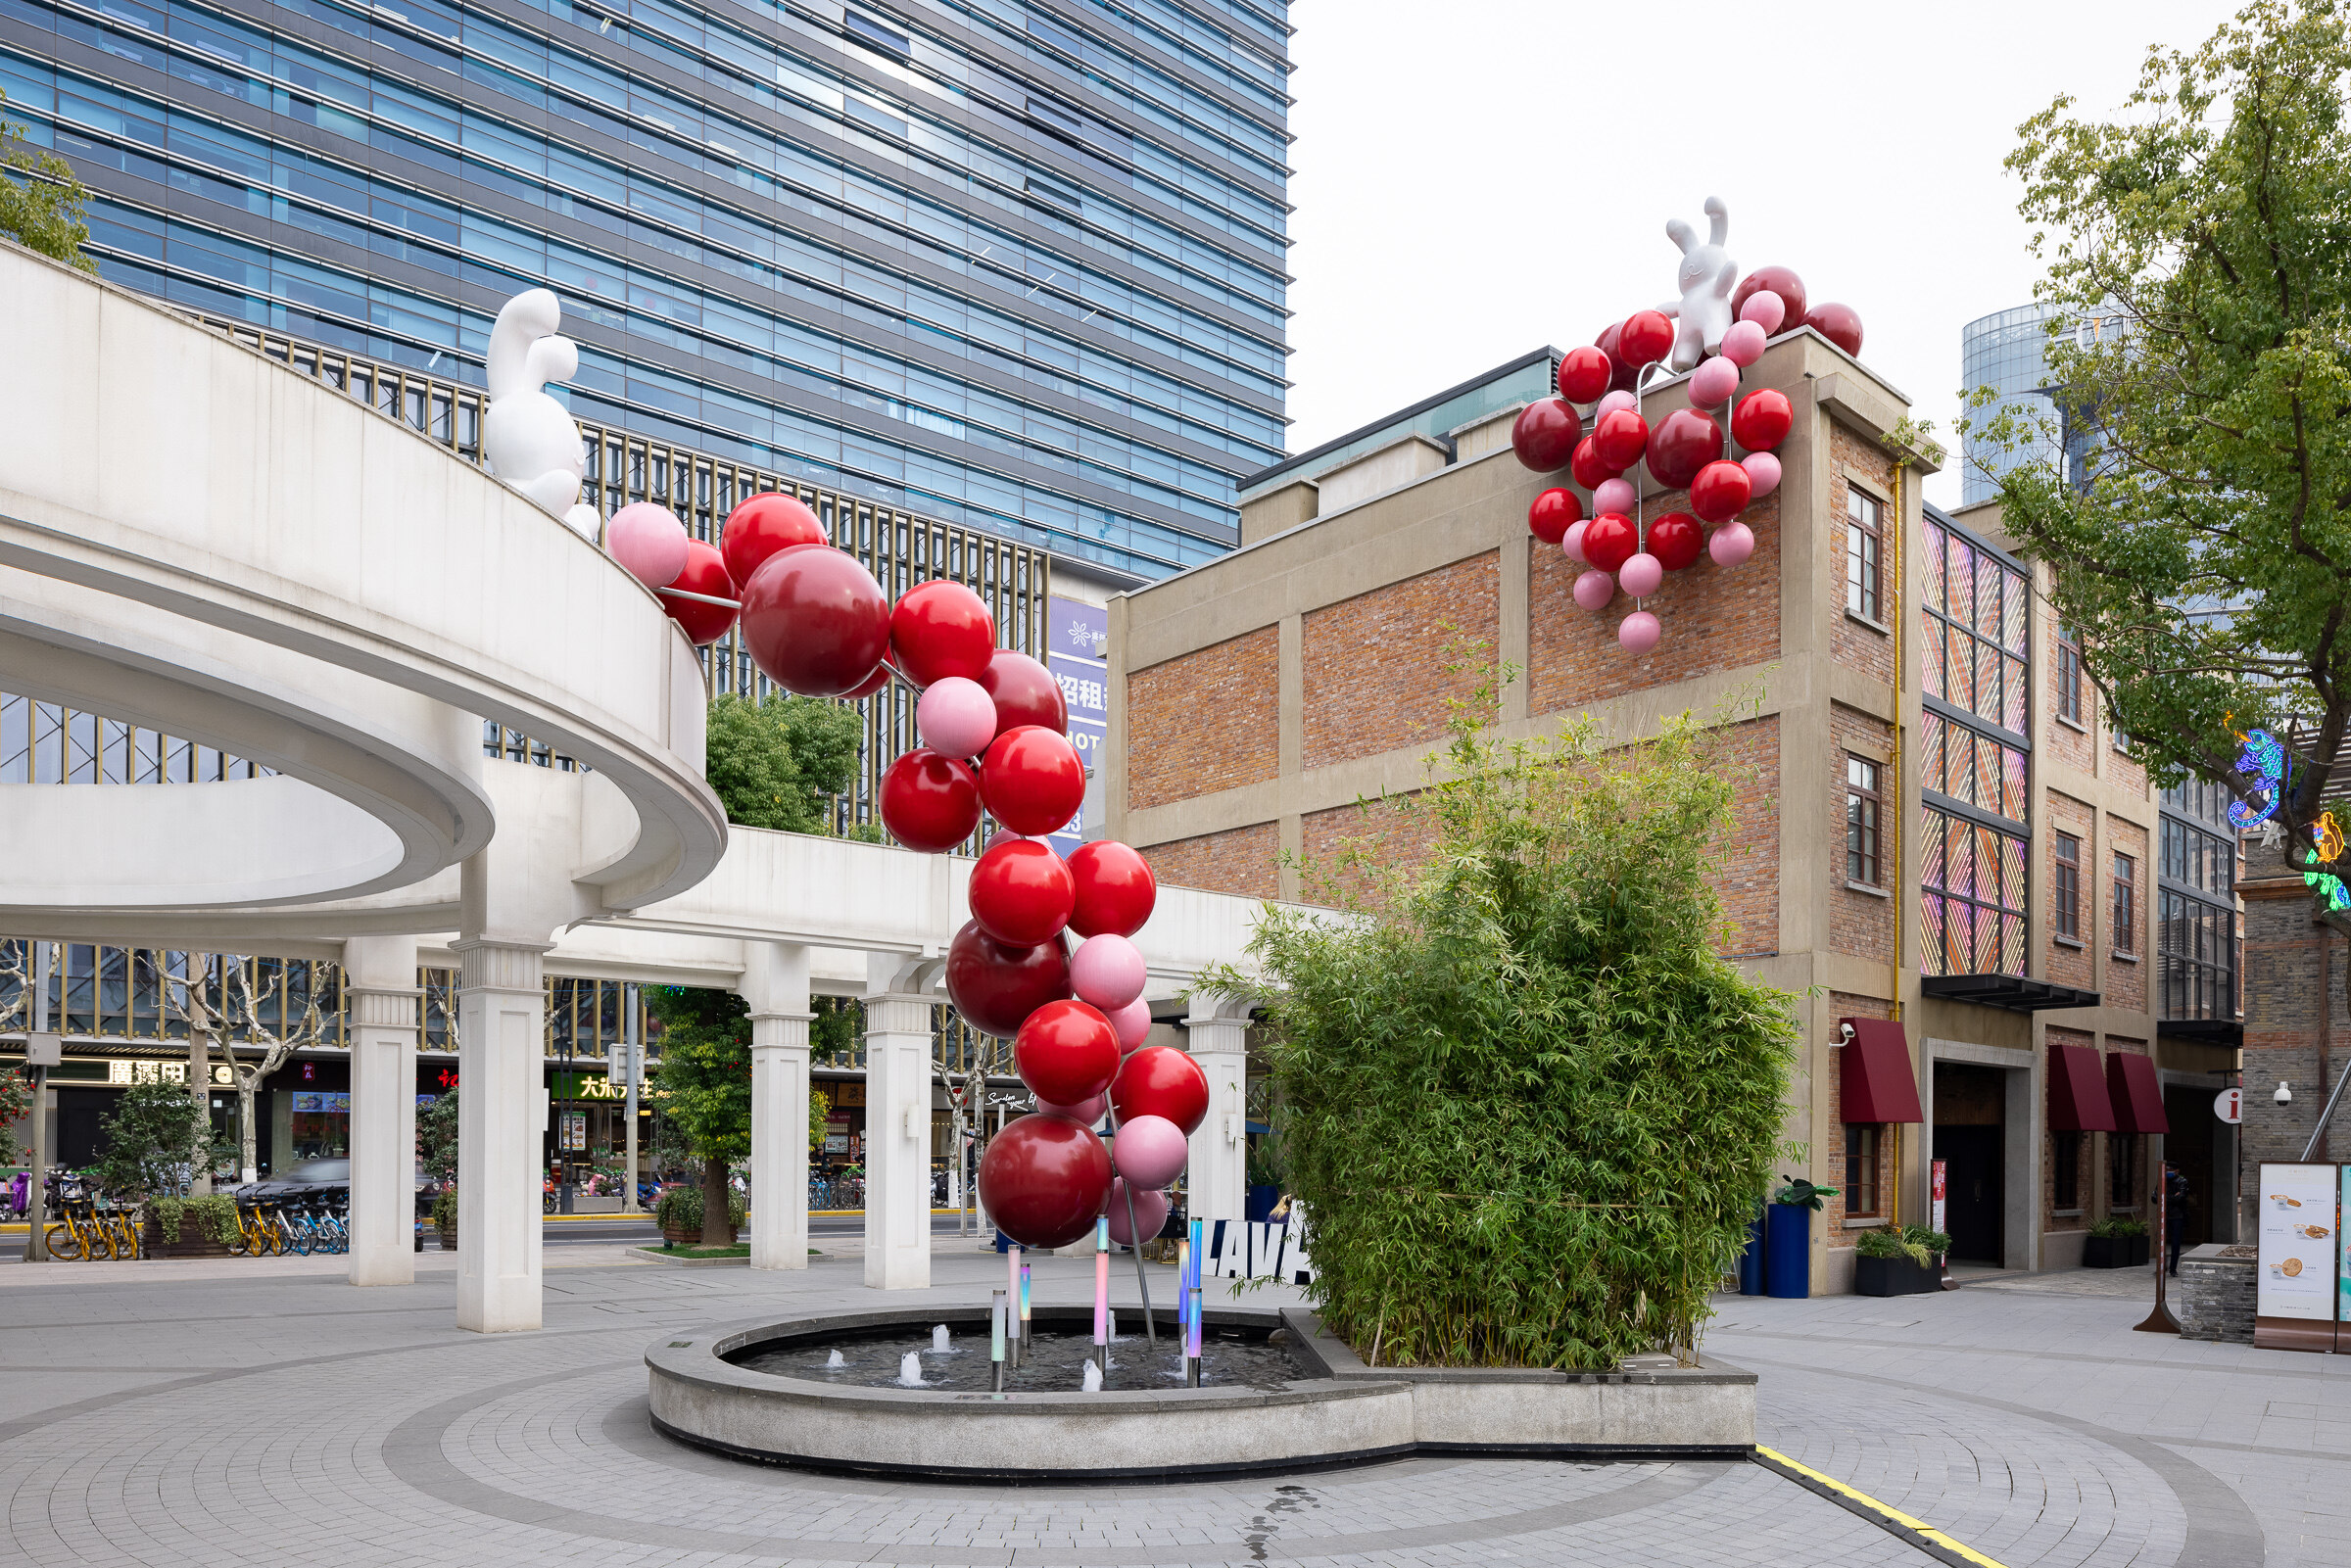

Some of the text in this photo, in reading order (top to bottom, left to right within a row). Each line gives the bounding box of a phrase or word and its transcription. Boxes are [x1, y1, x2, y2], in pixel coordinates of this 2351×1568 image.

[1055, 673, 1107, 713] 招租
[580, 1076, 653, 1098] 大米生
